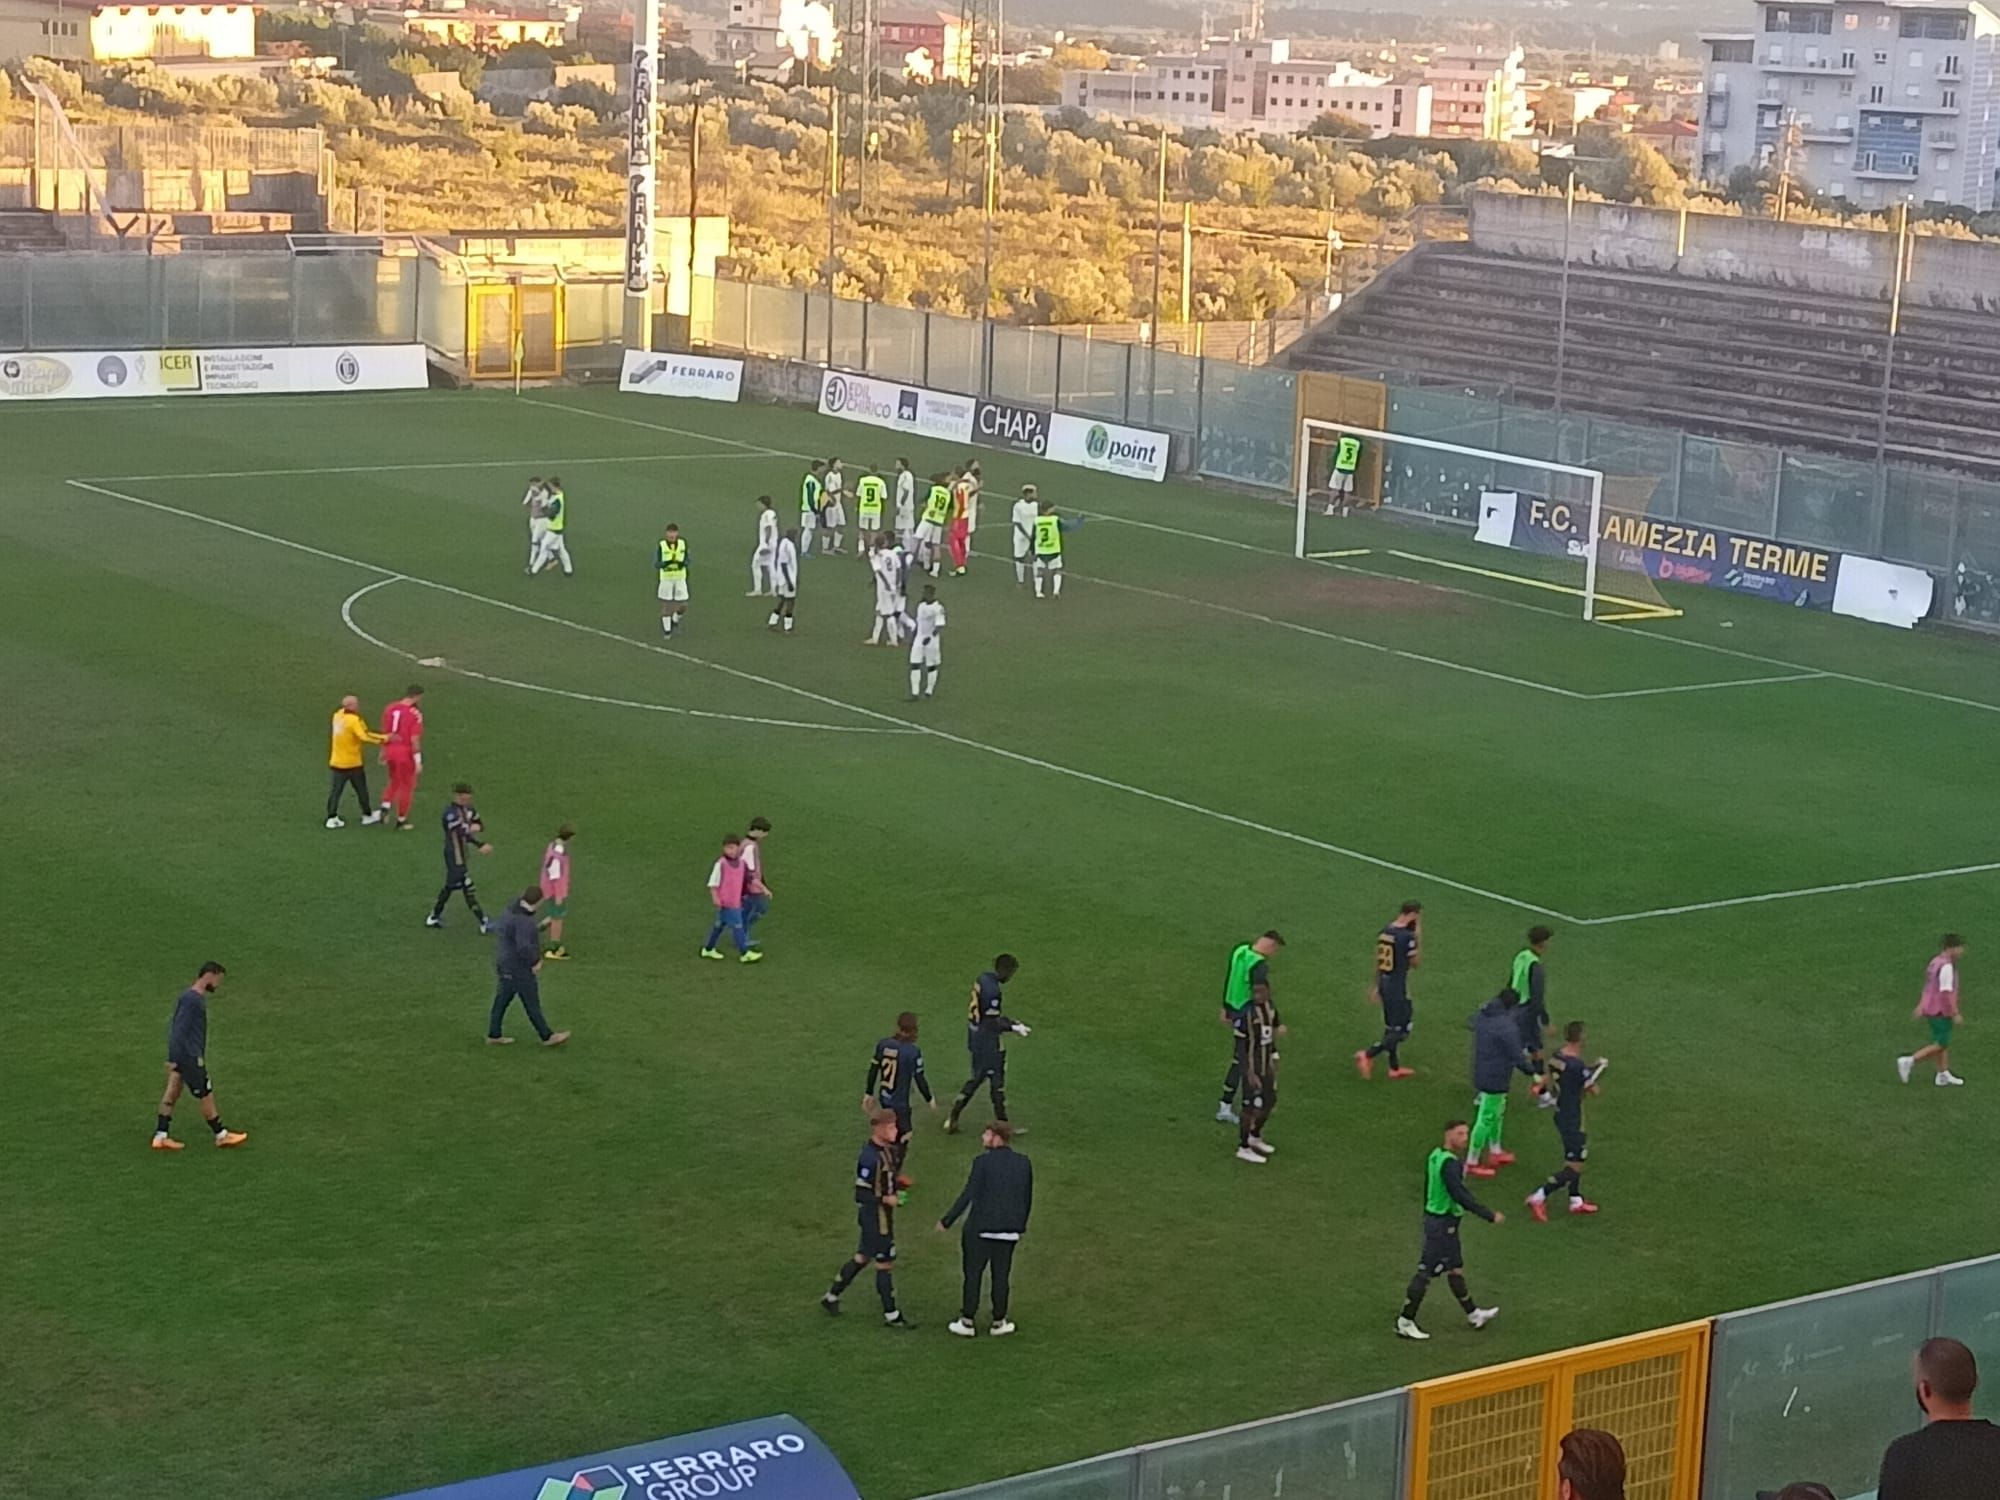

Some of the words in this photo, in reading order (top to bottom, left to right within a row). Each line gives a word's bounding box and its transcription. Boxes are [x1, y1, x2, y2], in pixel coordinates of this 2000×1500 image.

[160, 354, 192, 370] ICER
[671, 366, 735, 381] FERRARO
[848, 382, 871, 397] EDIL
[866, 488, 875, 502] 9
[1529, 500, 1577, 533] F.C.
[1598, 515, 1717, 561] AMEZIA
[1729, 537, 1828, 582] TERME
[392, 710, 400, 732] 1
[627, 1433, 805, 1485] FERRARO
[646, 1464, 757, 1500] GROUP
